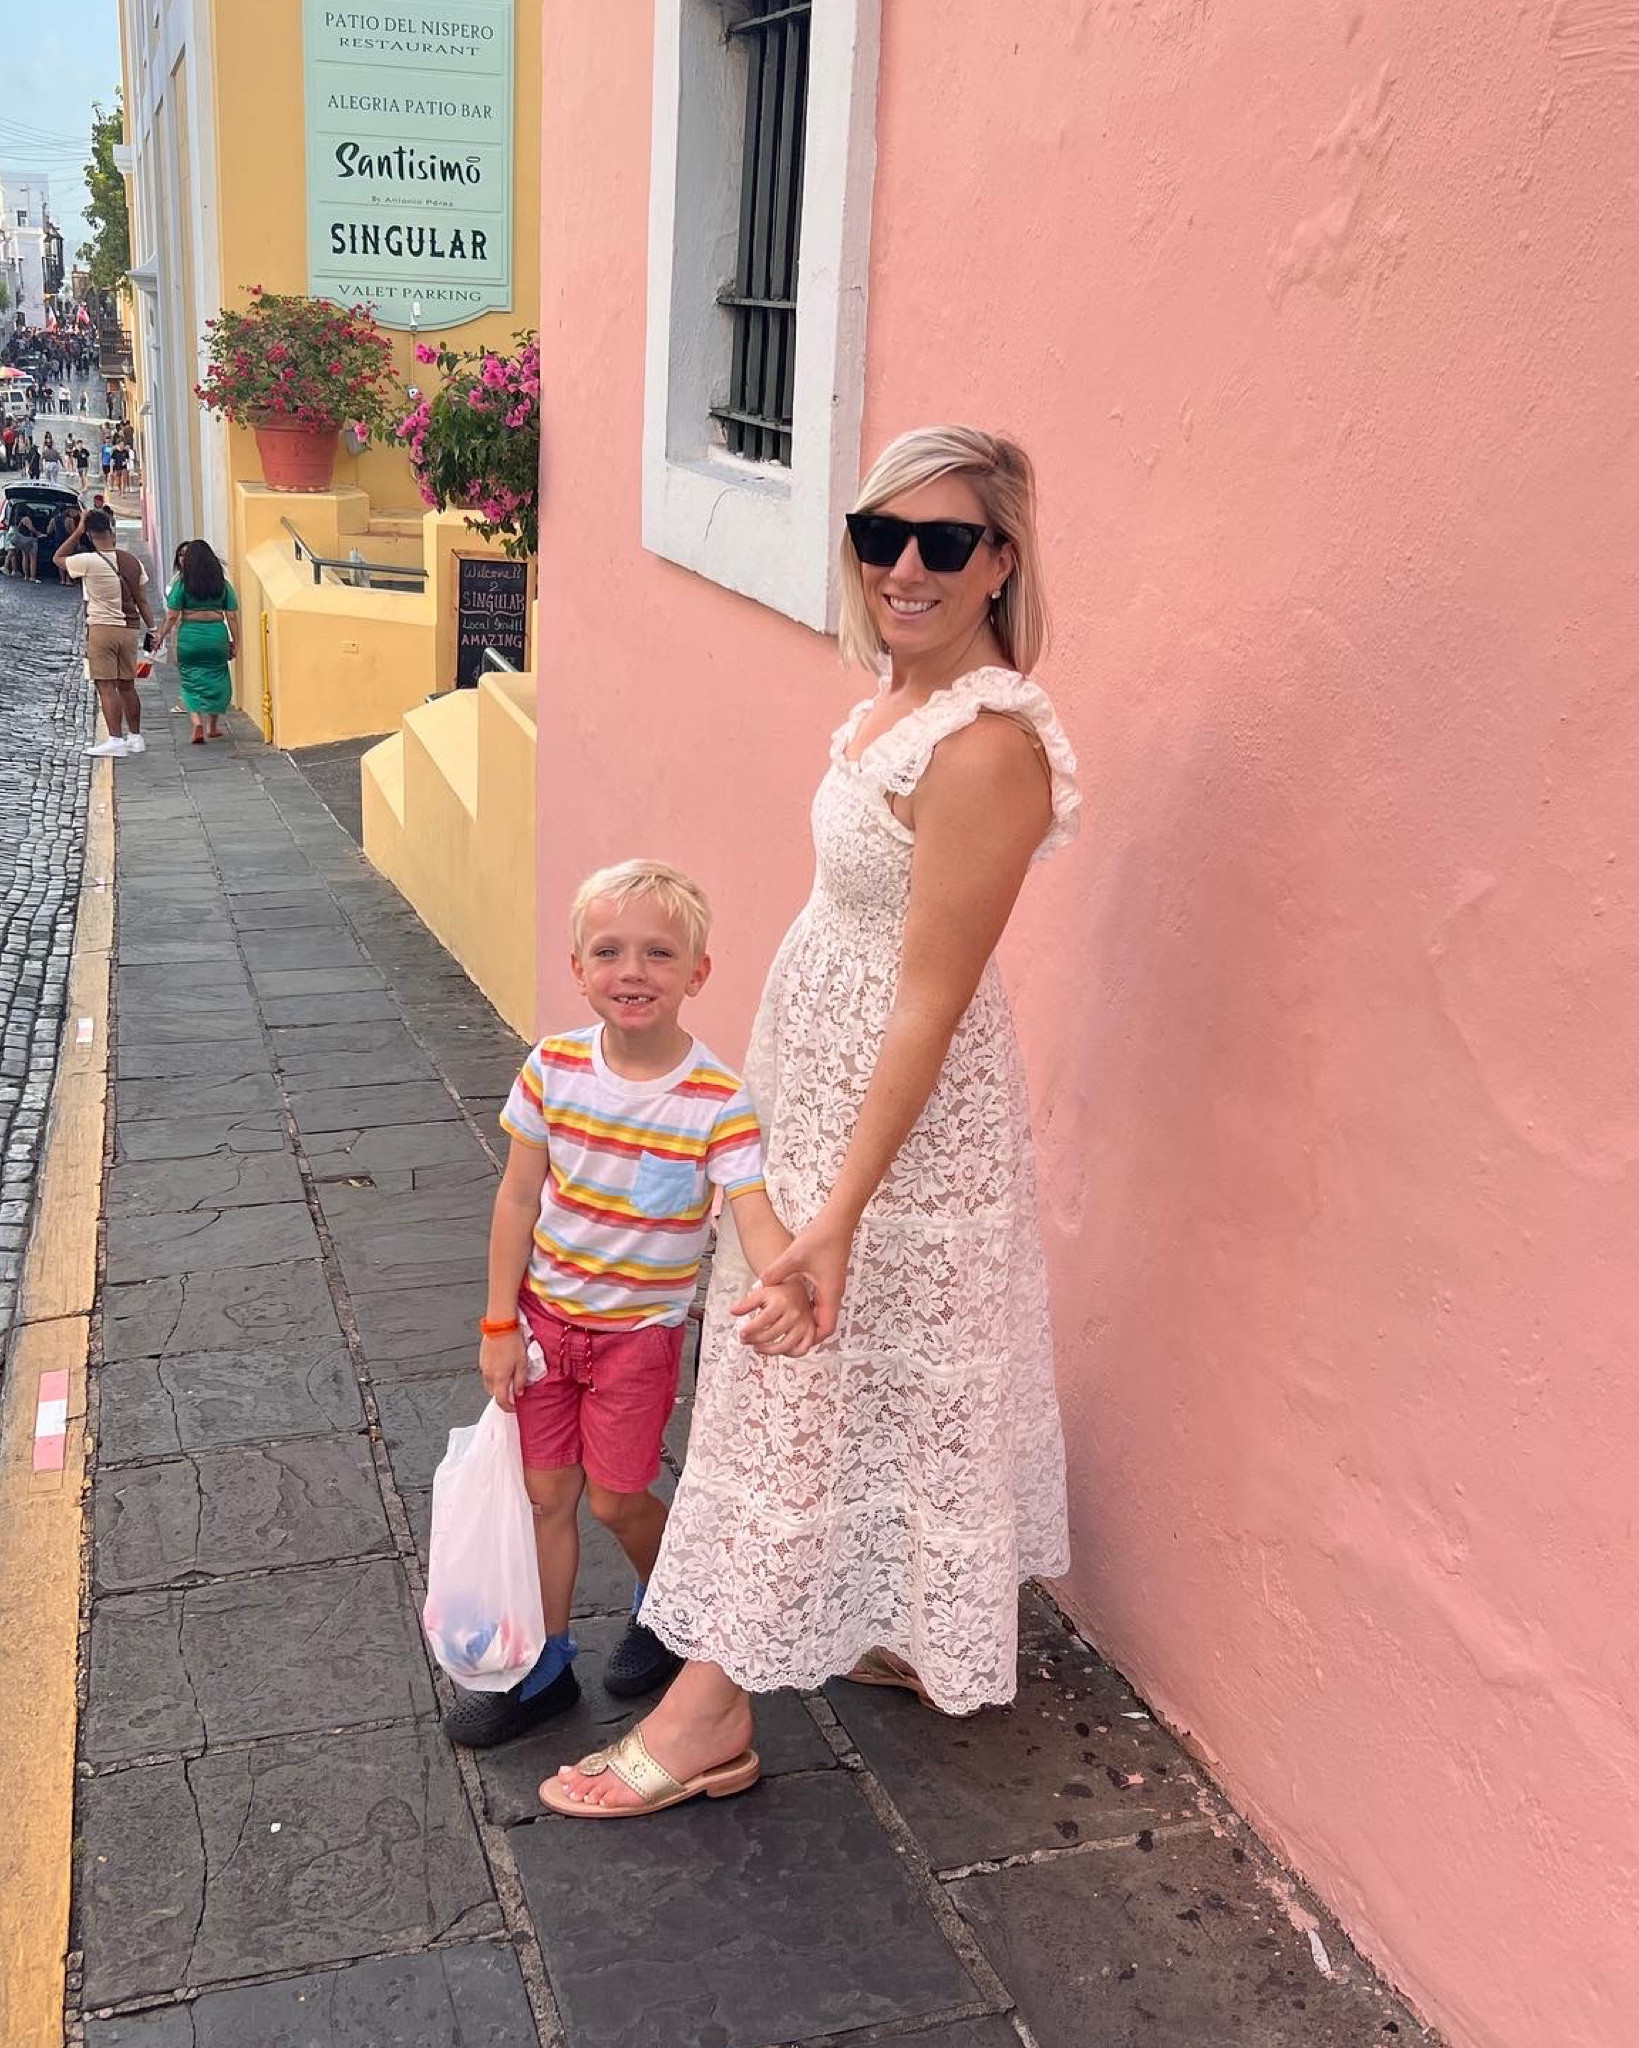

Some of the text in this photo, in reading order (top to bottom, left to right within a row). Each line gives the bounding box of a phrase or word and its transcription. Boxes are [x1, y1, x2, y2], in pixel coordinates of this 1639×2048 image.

[325, 12, 494, 40] PATIO DEL NISPERO
[339, 37, 480, 56] RESTAURANT
[327, 94, 493, 119] ALEGRIA PATIO BAR
[330, 222, 488, 260] SINGULAR
[338, 284, 482, 302] VALET PARKING
[462, 591, 525, 612] SINGULAR
[461, 633, 522, 648] AMAZING
